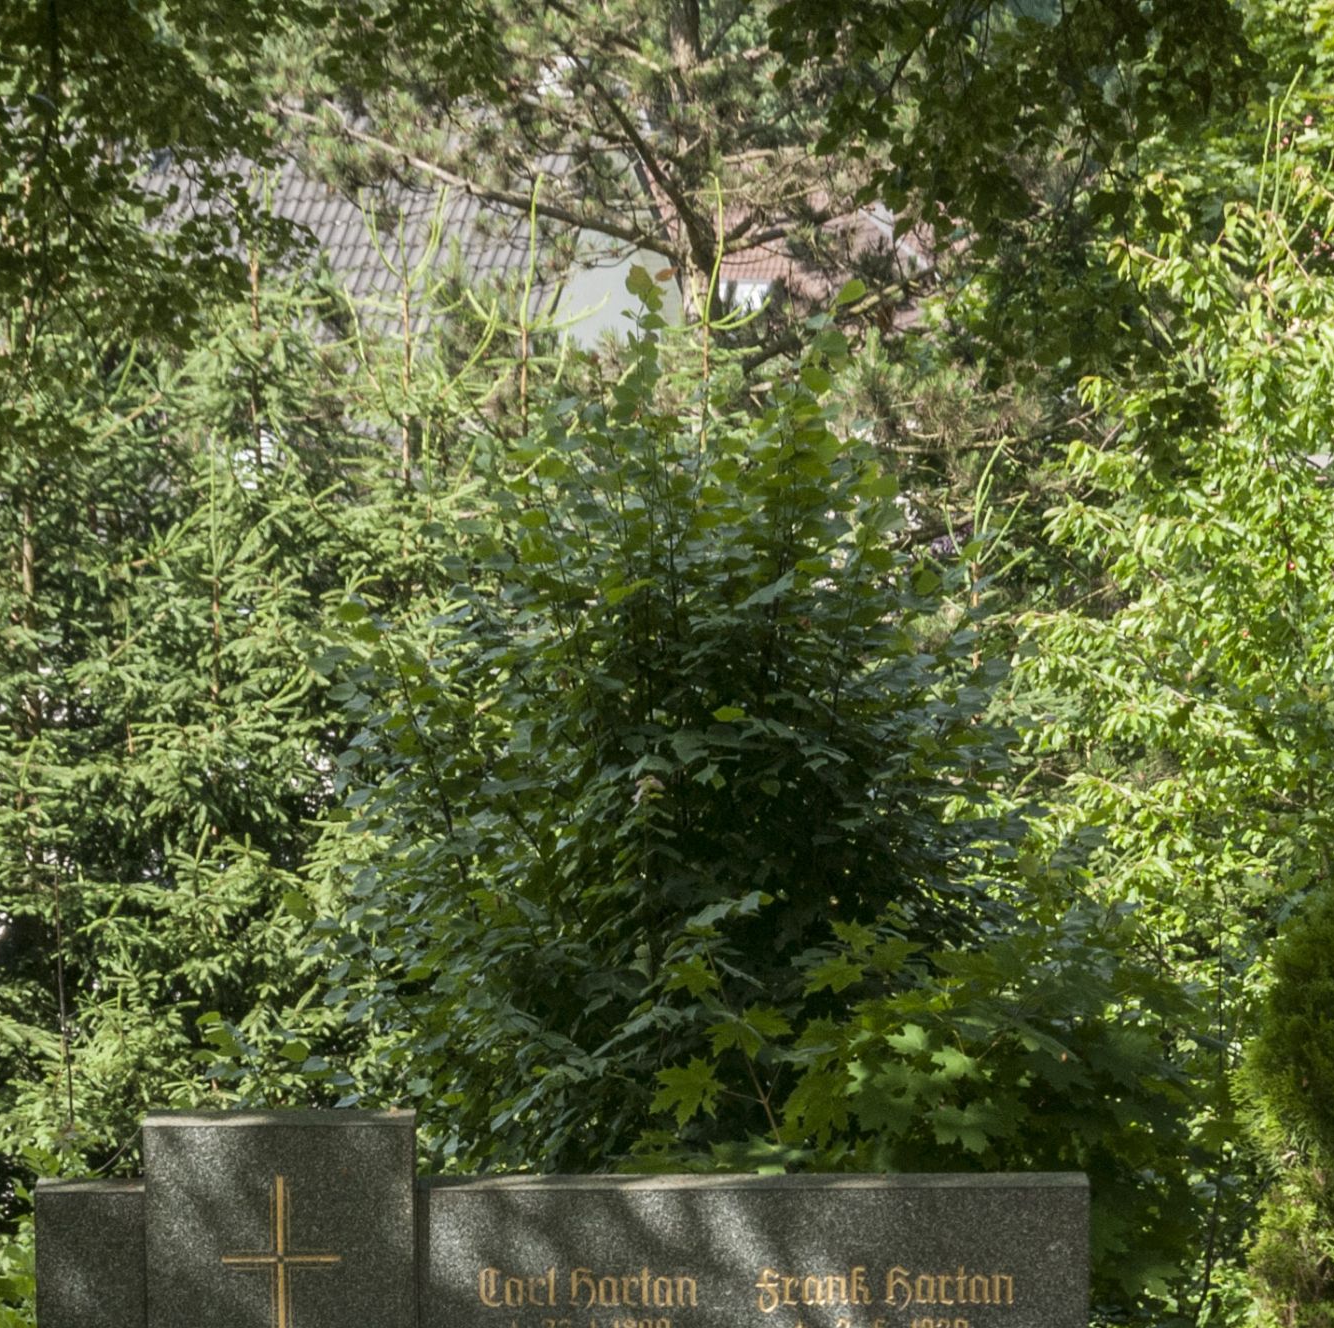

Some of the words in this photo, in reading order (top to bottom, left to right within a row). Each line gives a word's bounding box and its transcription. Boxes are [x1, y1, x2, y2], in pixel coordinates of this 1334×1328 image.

[479, 1266, 556, 1307] Carl
[570, 1266, 698, 1308] Hartan
[755, 1266, 872, 1313] Frank
[885, 1264, 1014, 1311] Hartan
